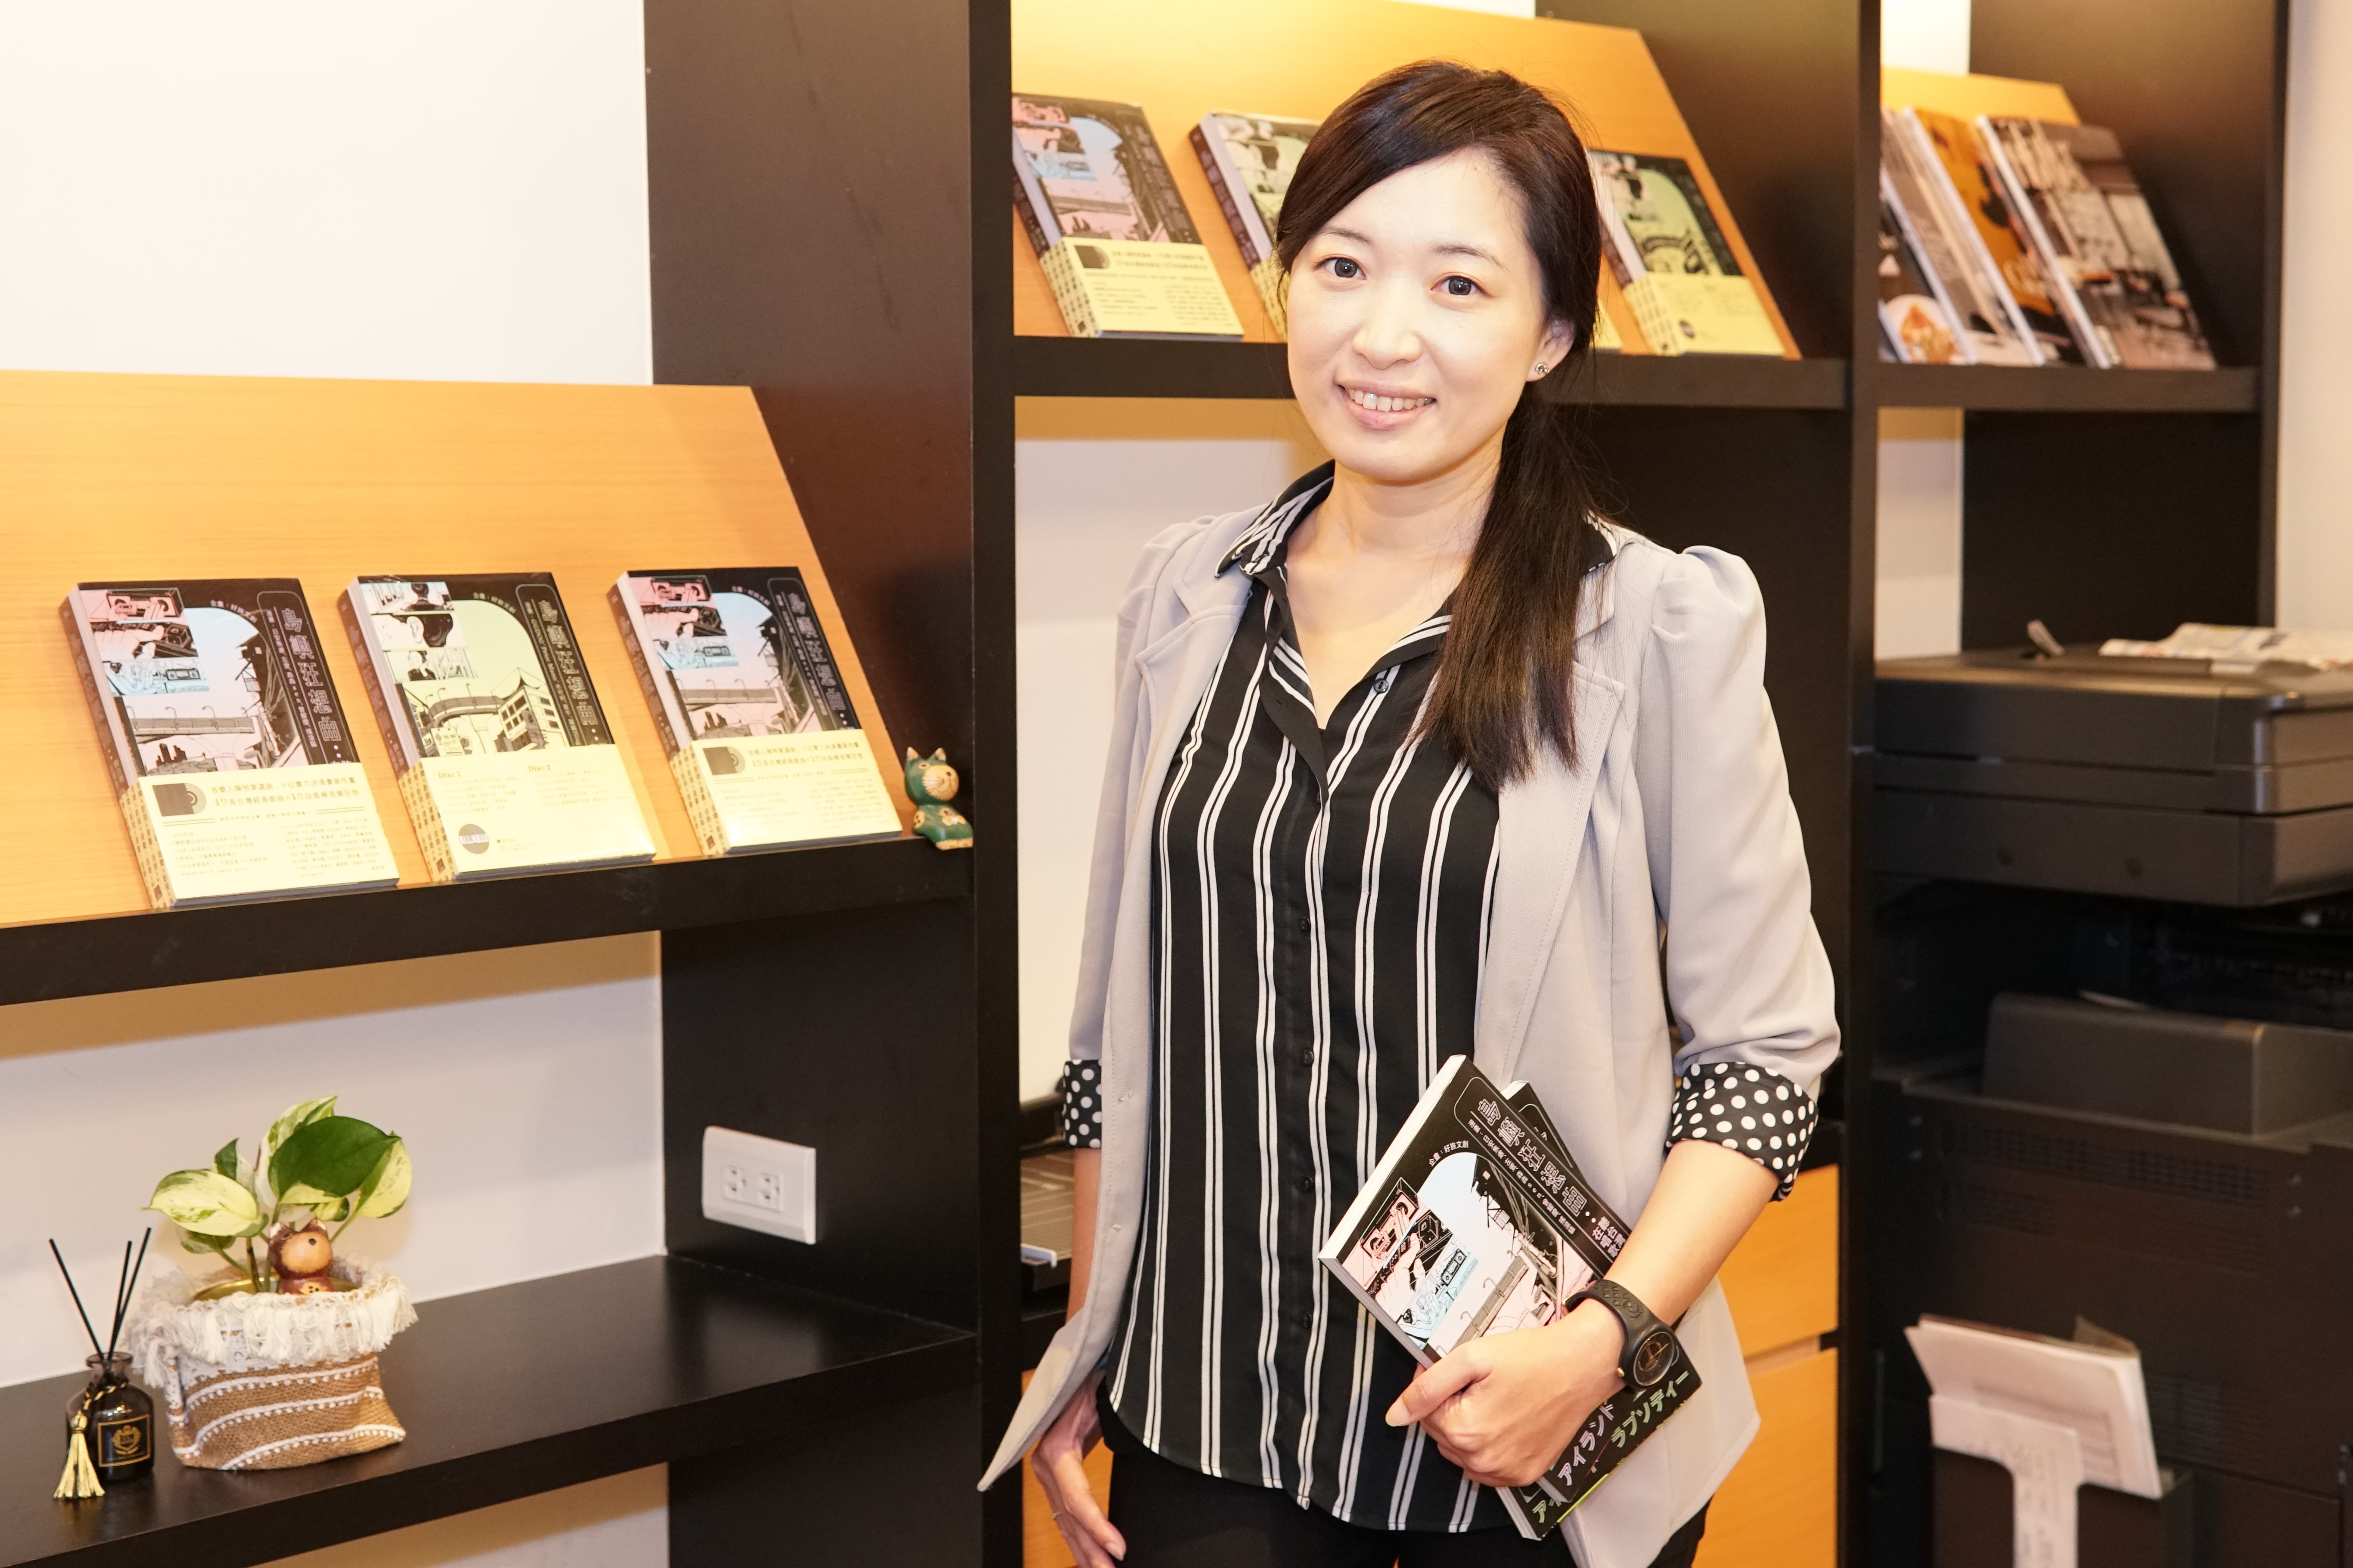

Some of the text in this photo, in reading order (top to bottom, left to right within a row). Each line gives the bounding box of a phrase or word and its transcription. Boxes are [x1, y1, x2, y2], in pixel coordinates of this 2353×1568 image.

[1478, 1099, 1587, 1217] 島嶼狂想曲
